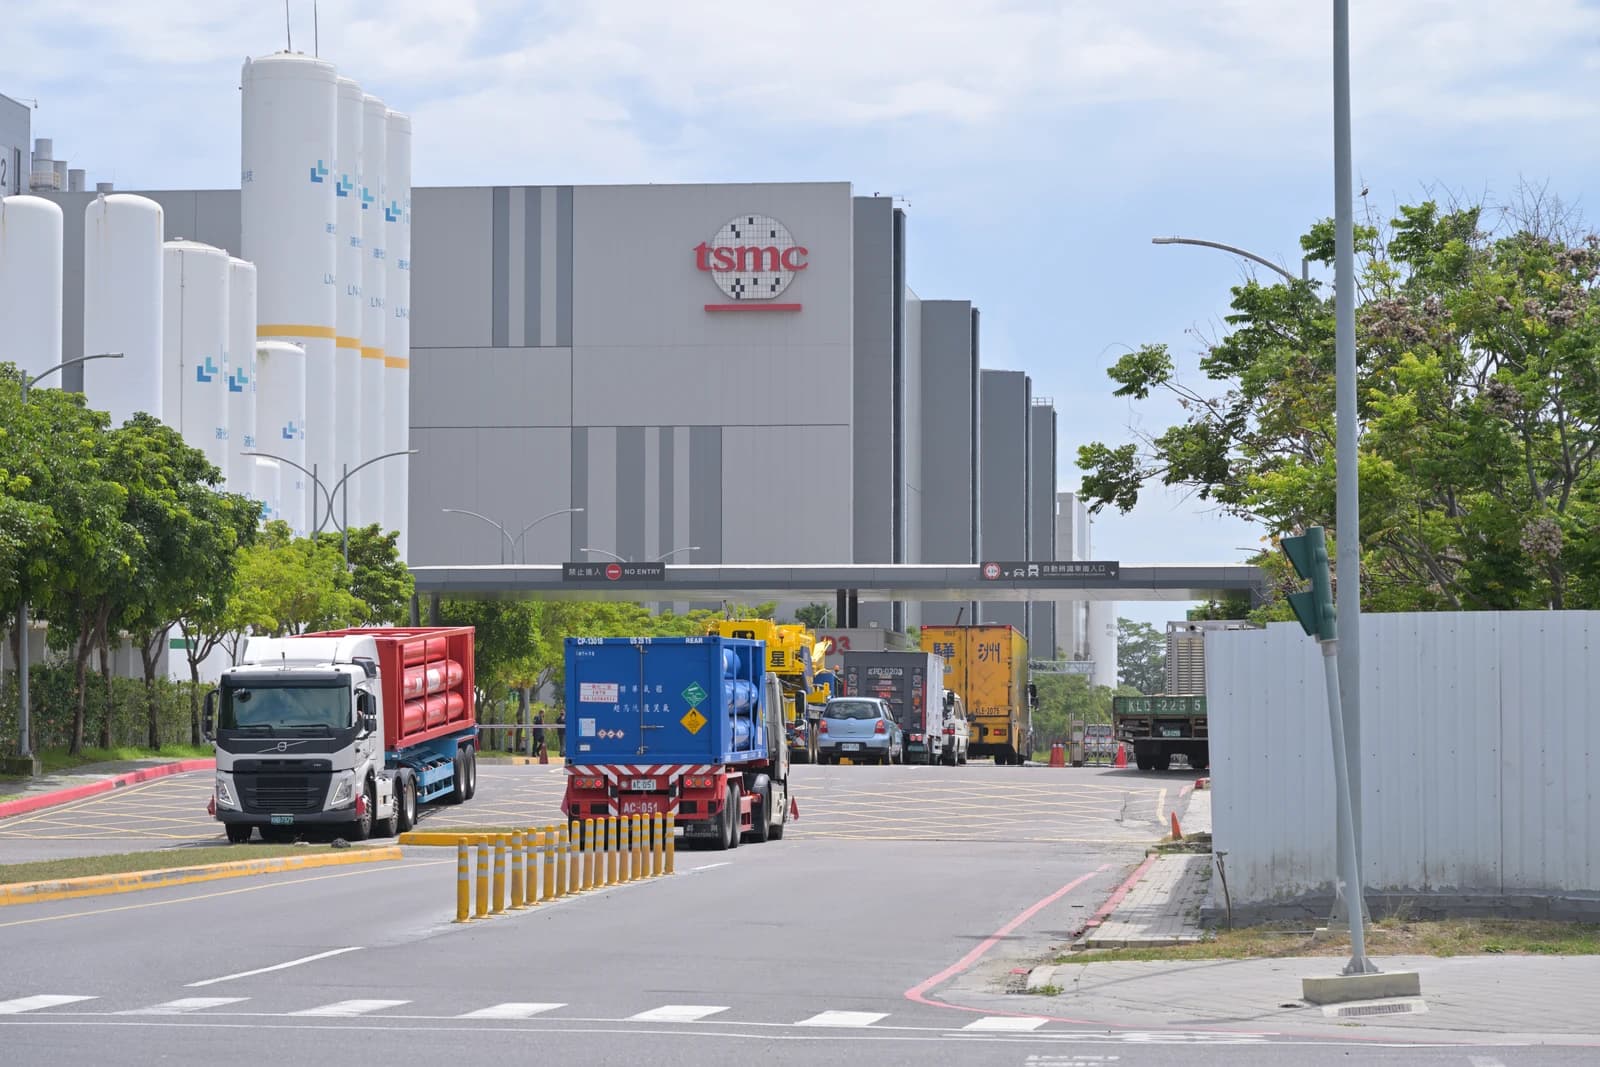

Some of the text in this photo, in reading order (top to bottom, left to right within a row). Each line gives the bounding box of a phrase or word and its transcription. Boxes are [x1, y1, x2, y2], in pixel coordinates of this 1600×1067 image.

[693, 240, 809, 273] tsmc
[568, 568, 601, 576] 禁止進入
[623, 801, 658, 813] AC-051
